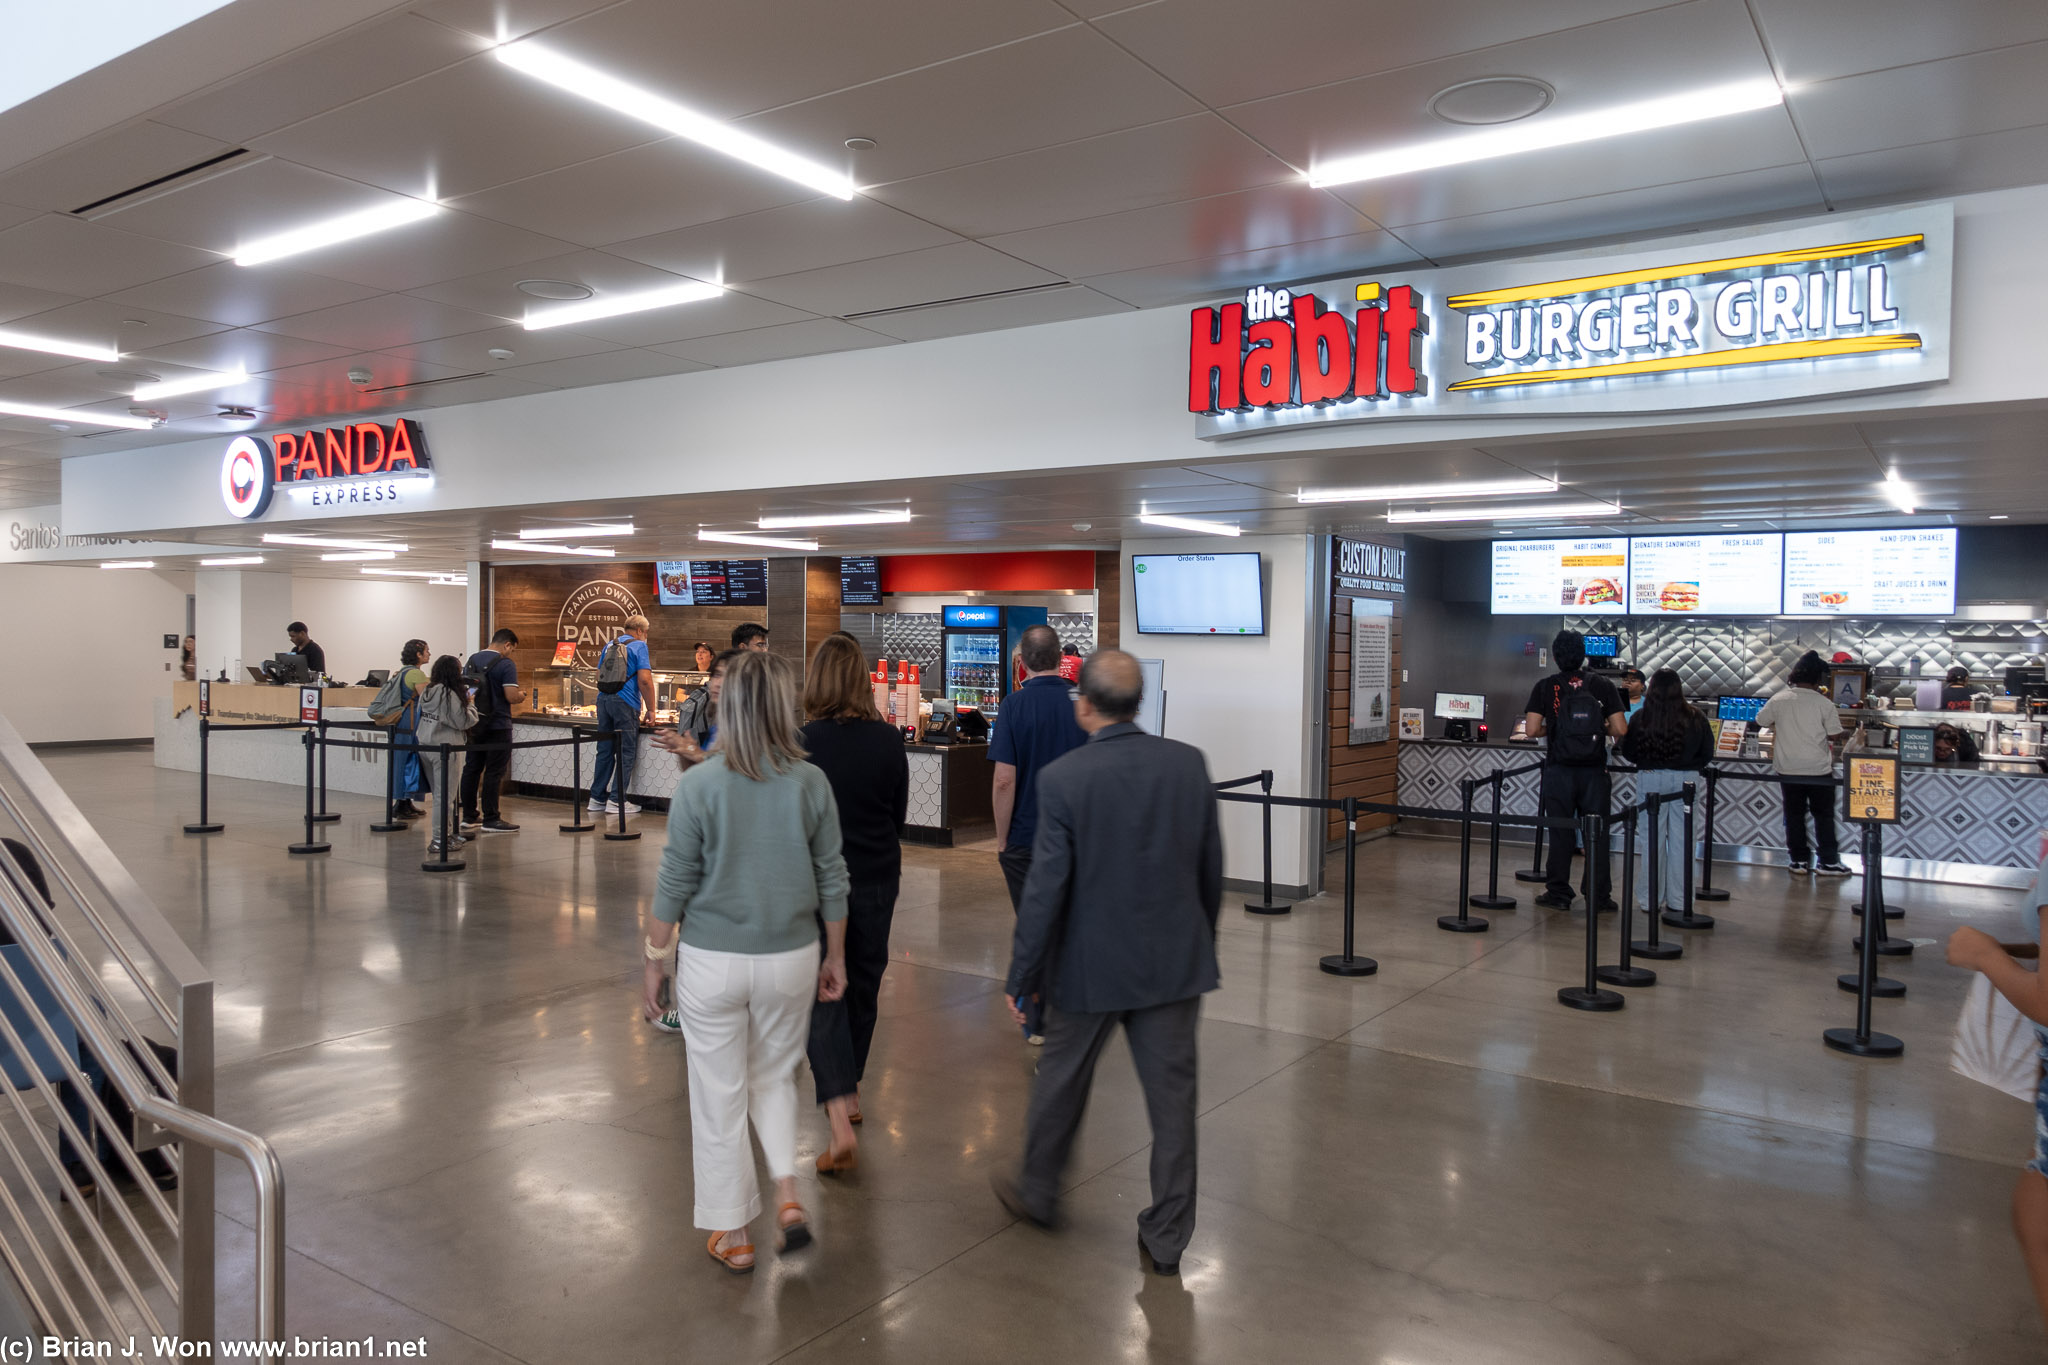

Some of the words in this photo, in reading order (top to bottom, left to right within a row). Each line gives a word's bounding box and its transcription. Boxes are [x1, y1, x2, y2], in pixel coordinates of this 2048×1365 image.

[1247, 285, 1290, 321] the
[1465, 287, 1697, 366] BURGER
[1714, 264, 1898, 339] GRILL
[1188, 282, 1419, 413] Habit
[273, 418, 418, 482] PANDA
[312, 484, 397, 506] EXPRESS
[10, 521, 61, 551] Santos
[1742, 538, 1764, 546] SALADS
[1520, 544, 1555, 552] CHARBURGERS
[1634, 541, 1663, 549] SIGNATURE
[1665, 540, 1701, 548] SANDWICHES
[1196, 554, 1215, 562] Status
[1340, 540, 1380, 577] CUSTOM
[1381, 547, 1406, 580] BUILT
[1340, 577, 1360, 588] QUALITY
[1360, 579, 1371, 589] FOOD
[1372, 580, 1384, 591] MADE
[1895, 580, 1917, 588] JUICES
[567, 586, 601, 616] FAMILY
[605, 586, 638, 617] OWNED
[1563, 593, 1576, 601] CHAR
[1802, 592, 1819, 600] ONION
[966, 611, 986, 621] pepsi
[563, 625, 625, 646] PAND
[1841, 682, 1854, 695] A
[1859, 779, 1884, 788] LINE
[1849, 787, 1895, 797] STARTS
